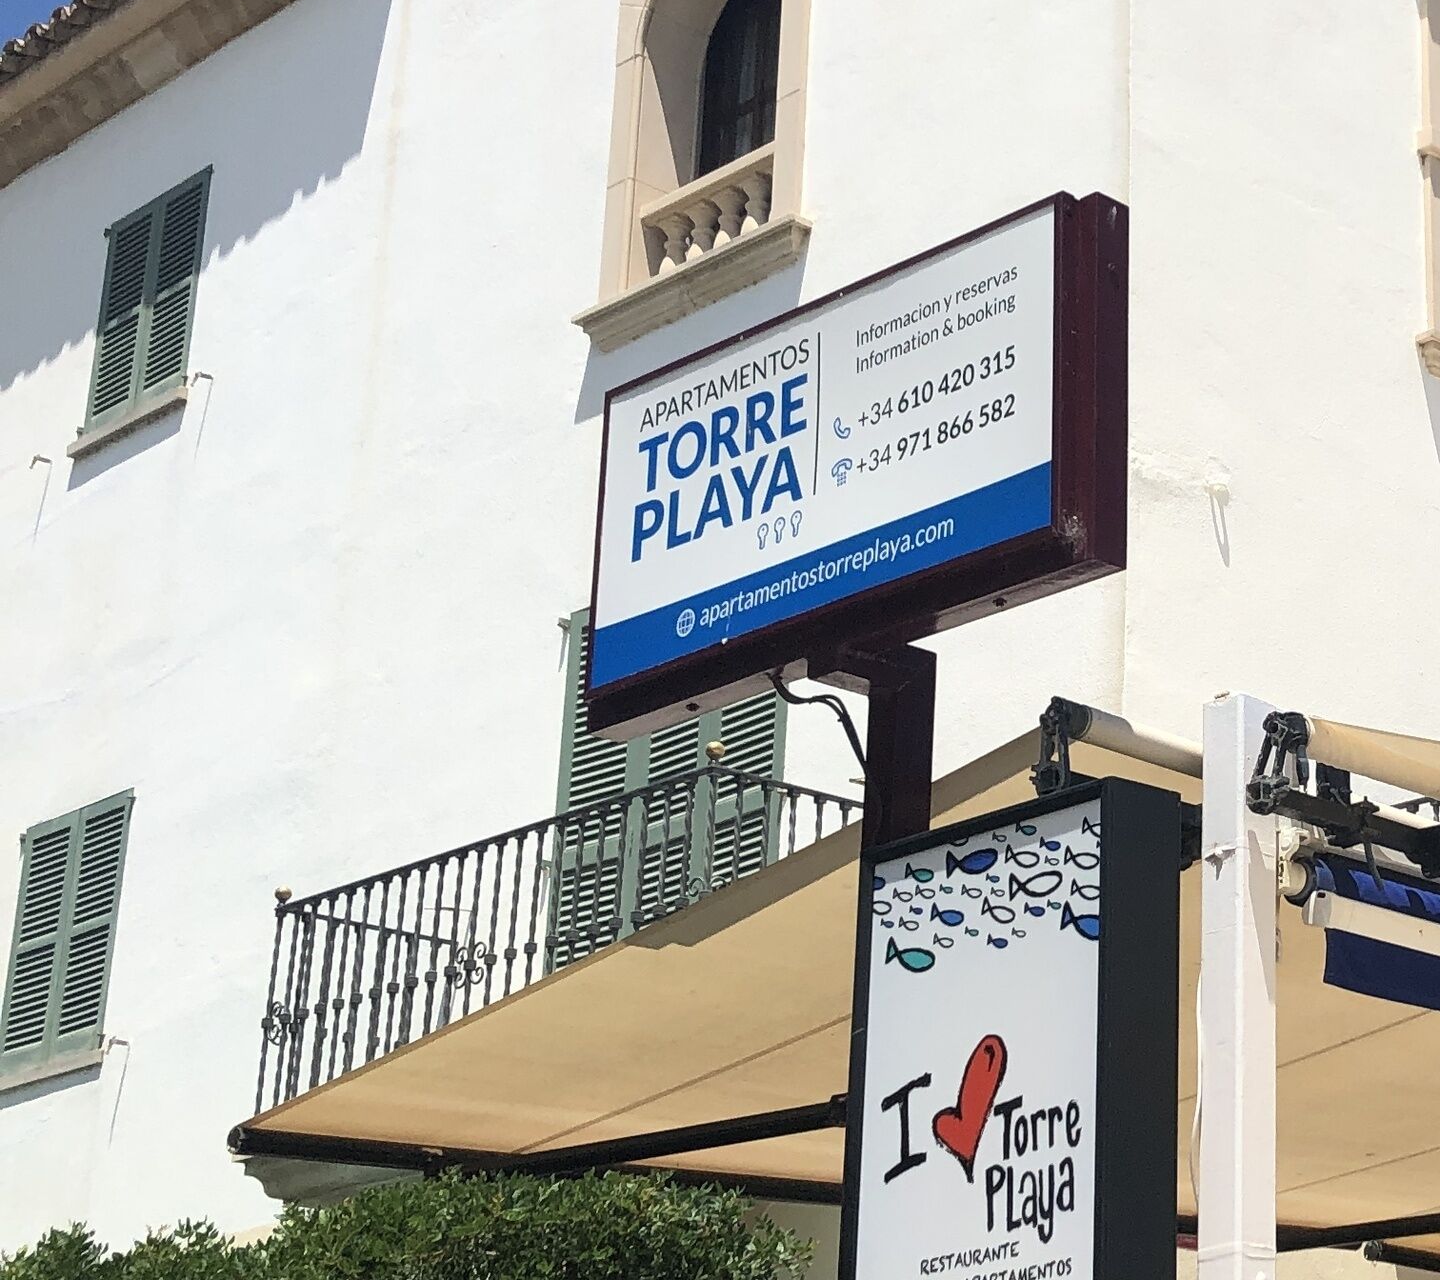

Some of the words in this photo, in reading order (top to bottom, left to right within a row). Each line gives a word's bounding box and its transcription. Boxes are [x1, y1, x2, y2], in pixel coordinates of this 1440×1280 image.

[856, 300, 941, 347] Informacion
[943, 294, 952, 312] y
[955, 266, 1018, 305] reservas
[856, 327, 939, 373] Information
[942, 318, 954, 337] &
[957, 294, 1016, 331] booking
[639, 338, 810, 433] APARTAMENTOS
[858, 397, 893, 427] +34
[897, 380, 934, 413] 610
[938, 363, 975, 396] 420
[979, 345, 1016, 380] 315
[638, 372, 809, 493] TORRE
[856, 443, 892, 473] +34
[897, 427, 932, 460] 971
[937, 410, 974, 444] 866
[978, 393, 1016, 428] 582
[631, 445, 803, 563] PLAYA
[699, 517, 955, 628] apartamentostorreplaya.com
[880, 1072, 932, 1184] I
[993, 1095, 1083, 1161] Torre
[919, 1240, 1020, 1276] RESTAURANTE
